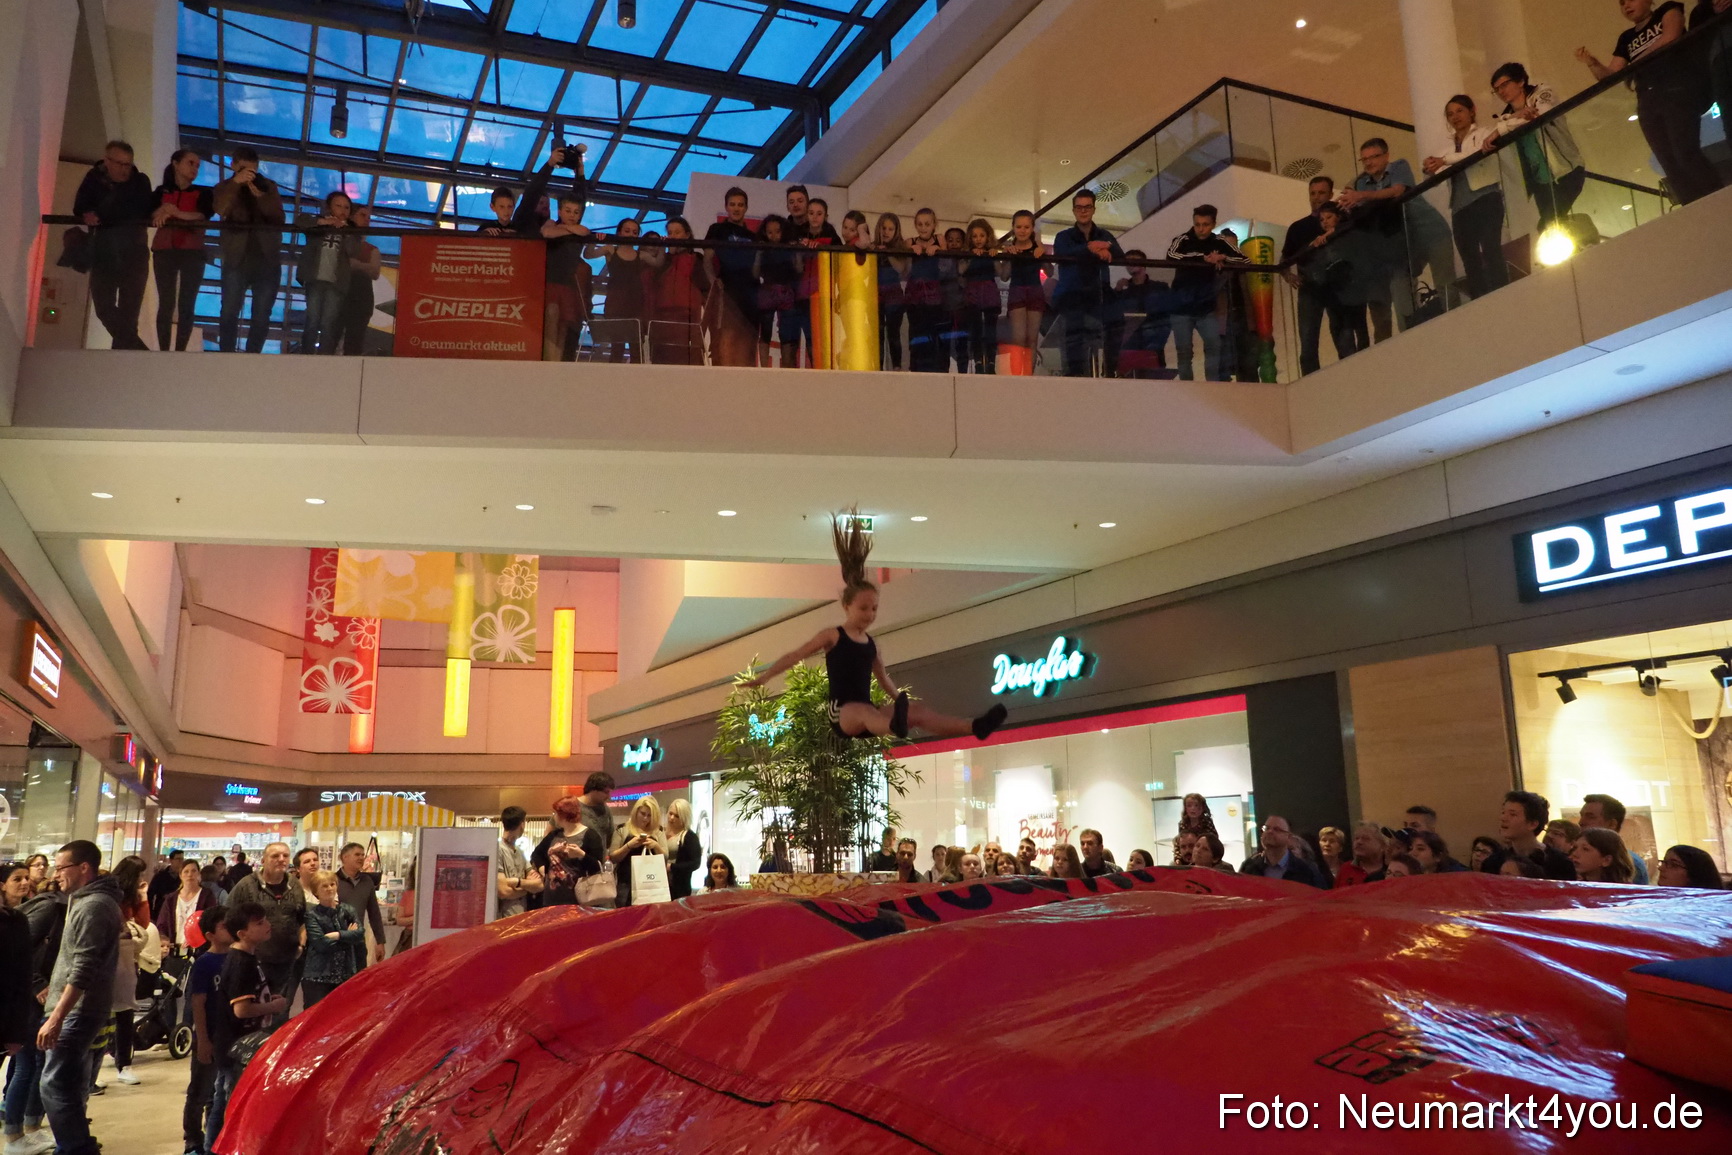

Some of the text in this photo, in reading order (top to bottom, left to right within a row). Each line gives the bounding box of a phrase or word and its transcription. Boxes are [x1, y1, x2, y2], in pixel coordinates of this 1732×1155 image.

[431, 262, 514, 276] NeuerMarkt
[414, 299, 525, 320] CINEPLEX
[421, 340, 526, 352] neumarkt aktuell
[991, 636, 1085, 698] Douglas
